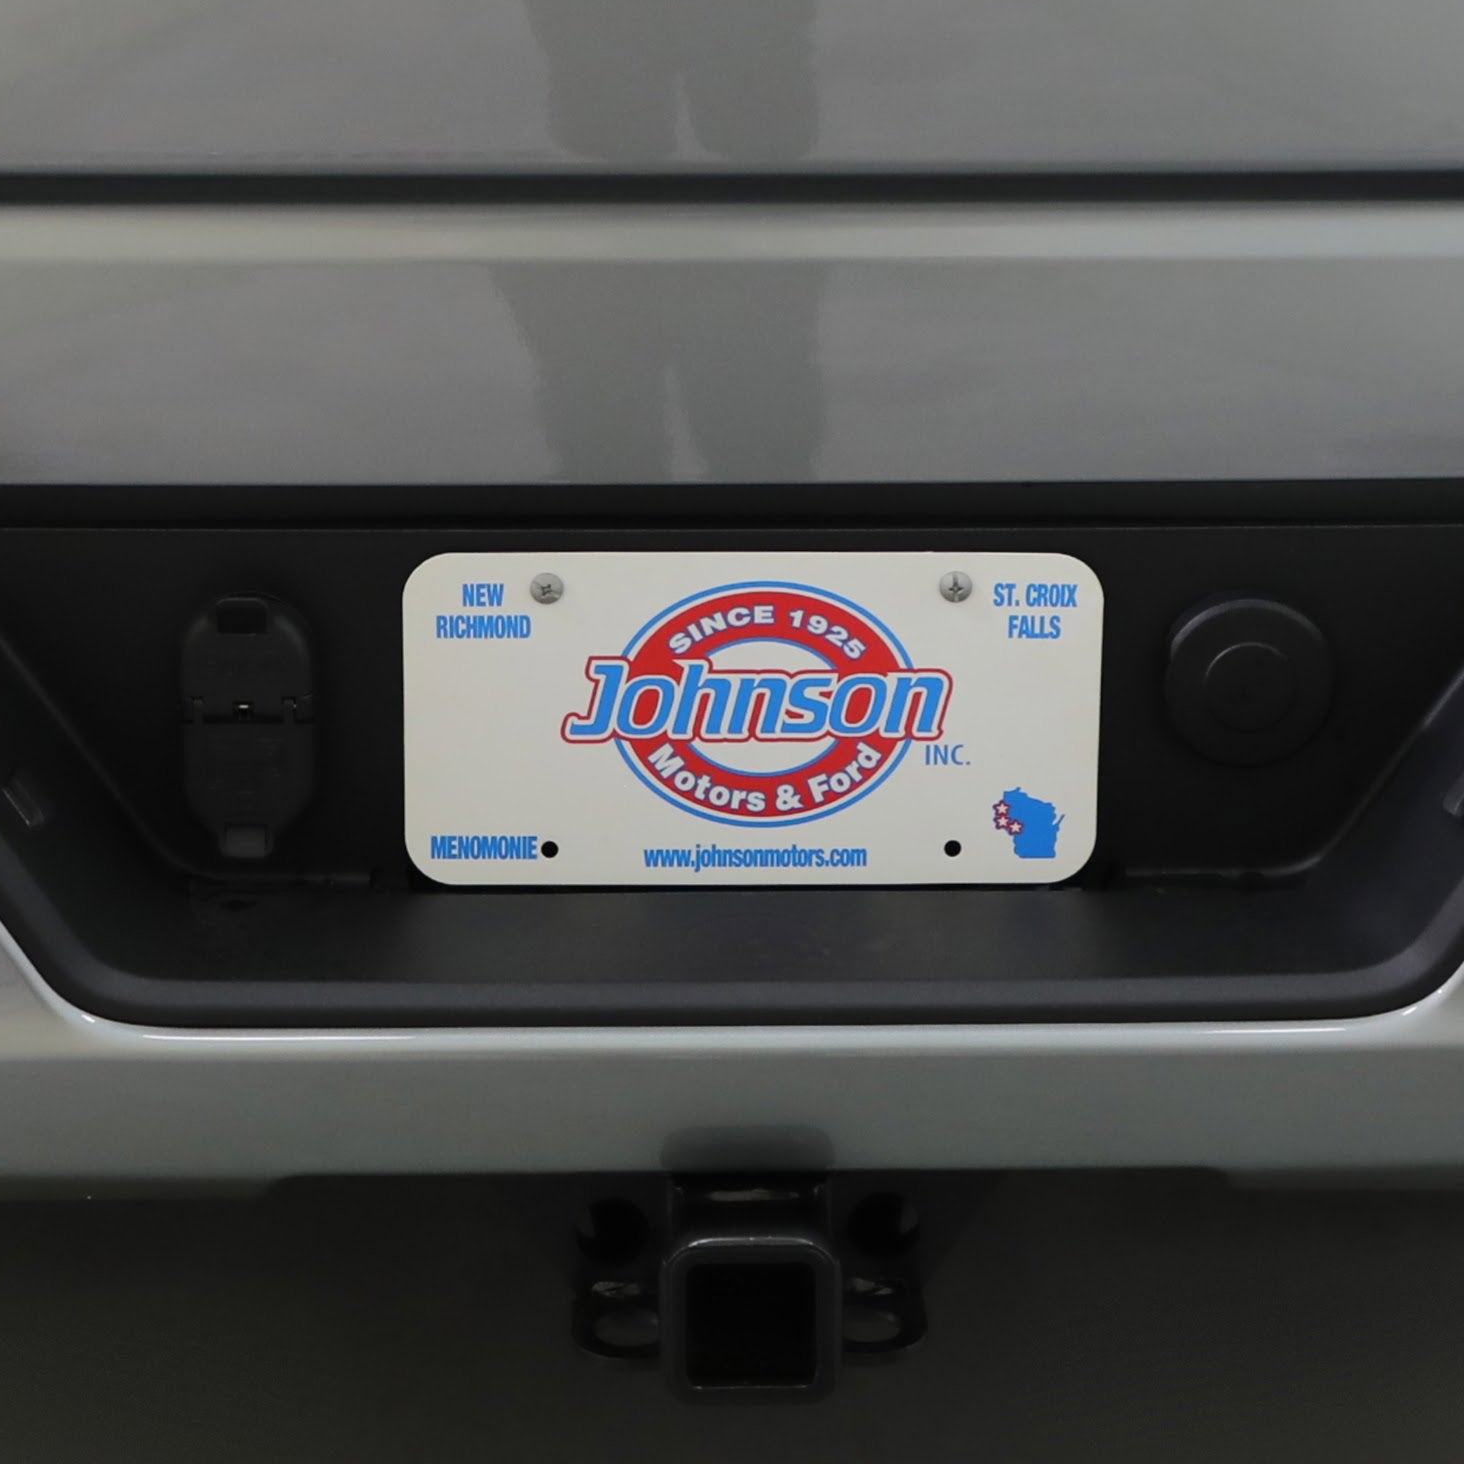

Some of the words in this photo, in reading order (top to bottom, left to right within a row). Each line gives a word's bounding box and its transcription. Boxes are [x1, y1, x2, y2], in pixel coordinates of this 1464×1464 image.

[461, 583, 505, 609] NEW
[992, 583, 1021, 609] ST.
[1024, 583, 1078, 609] CROIX
[436, 615, 532, 640] RICHMOND
[668, 604, 775, 656] SINCE
[788, 609, 867, 661] 1925
[1008, 614, 1062, 640] FALLS
[564, 658, 950, 741] Johnson
[924, 743, 972, 767] INC.
[646, 743, 767, 813] Motors
[775, 784, 804, 813] &
[807, 742, 883, 805] Ford
[430, 835, 539, 861] MENOMONIE
[643, 843, 869, 872] www.johnsonmotors.com
